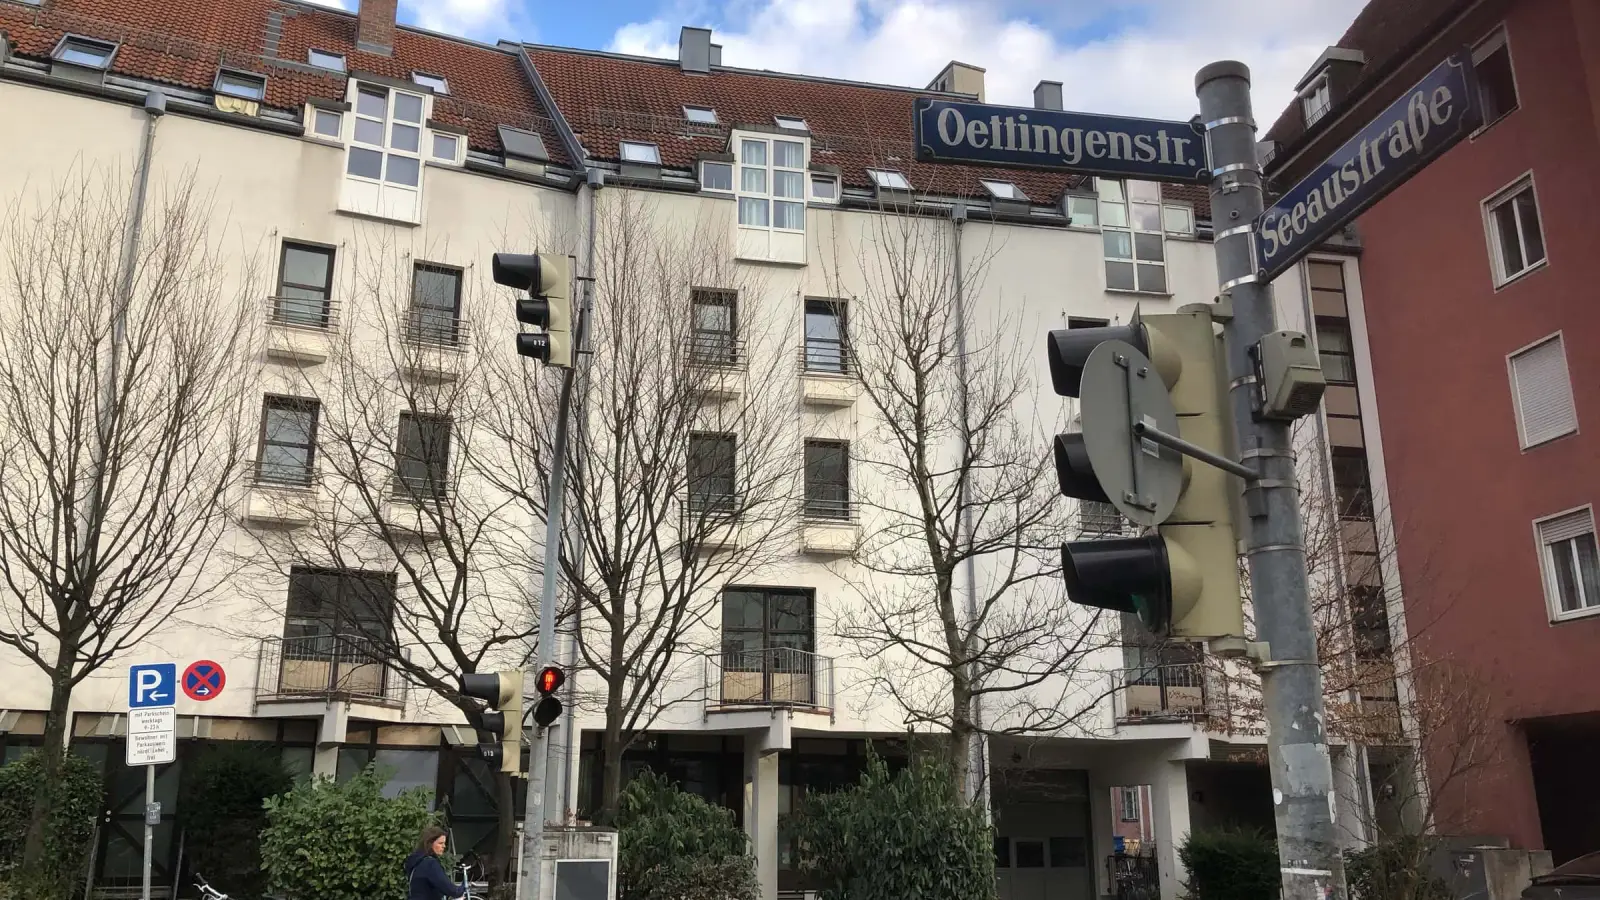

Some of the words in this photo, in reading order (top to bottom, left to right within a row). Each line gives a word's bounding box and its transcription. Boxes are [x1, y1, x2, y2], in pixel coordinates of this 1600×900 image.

[937, 107, 1197, 167] Oettingenstr.
[1261, 85, 1453, 262] Seeaustraße
[136, 669, 162, 703] P
